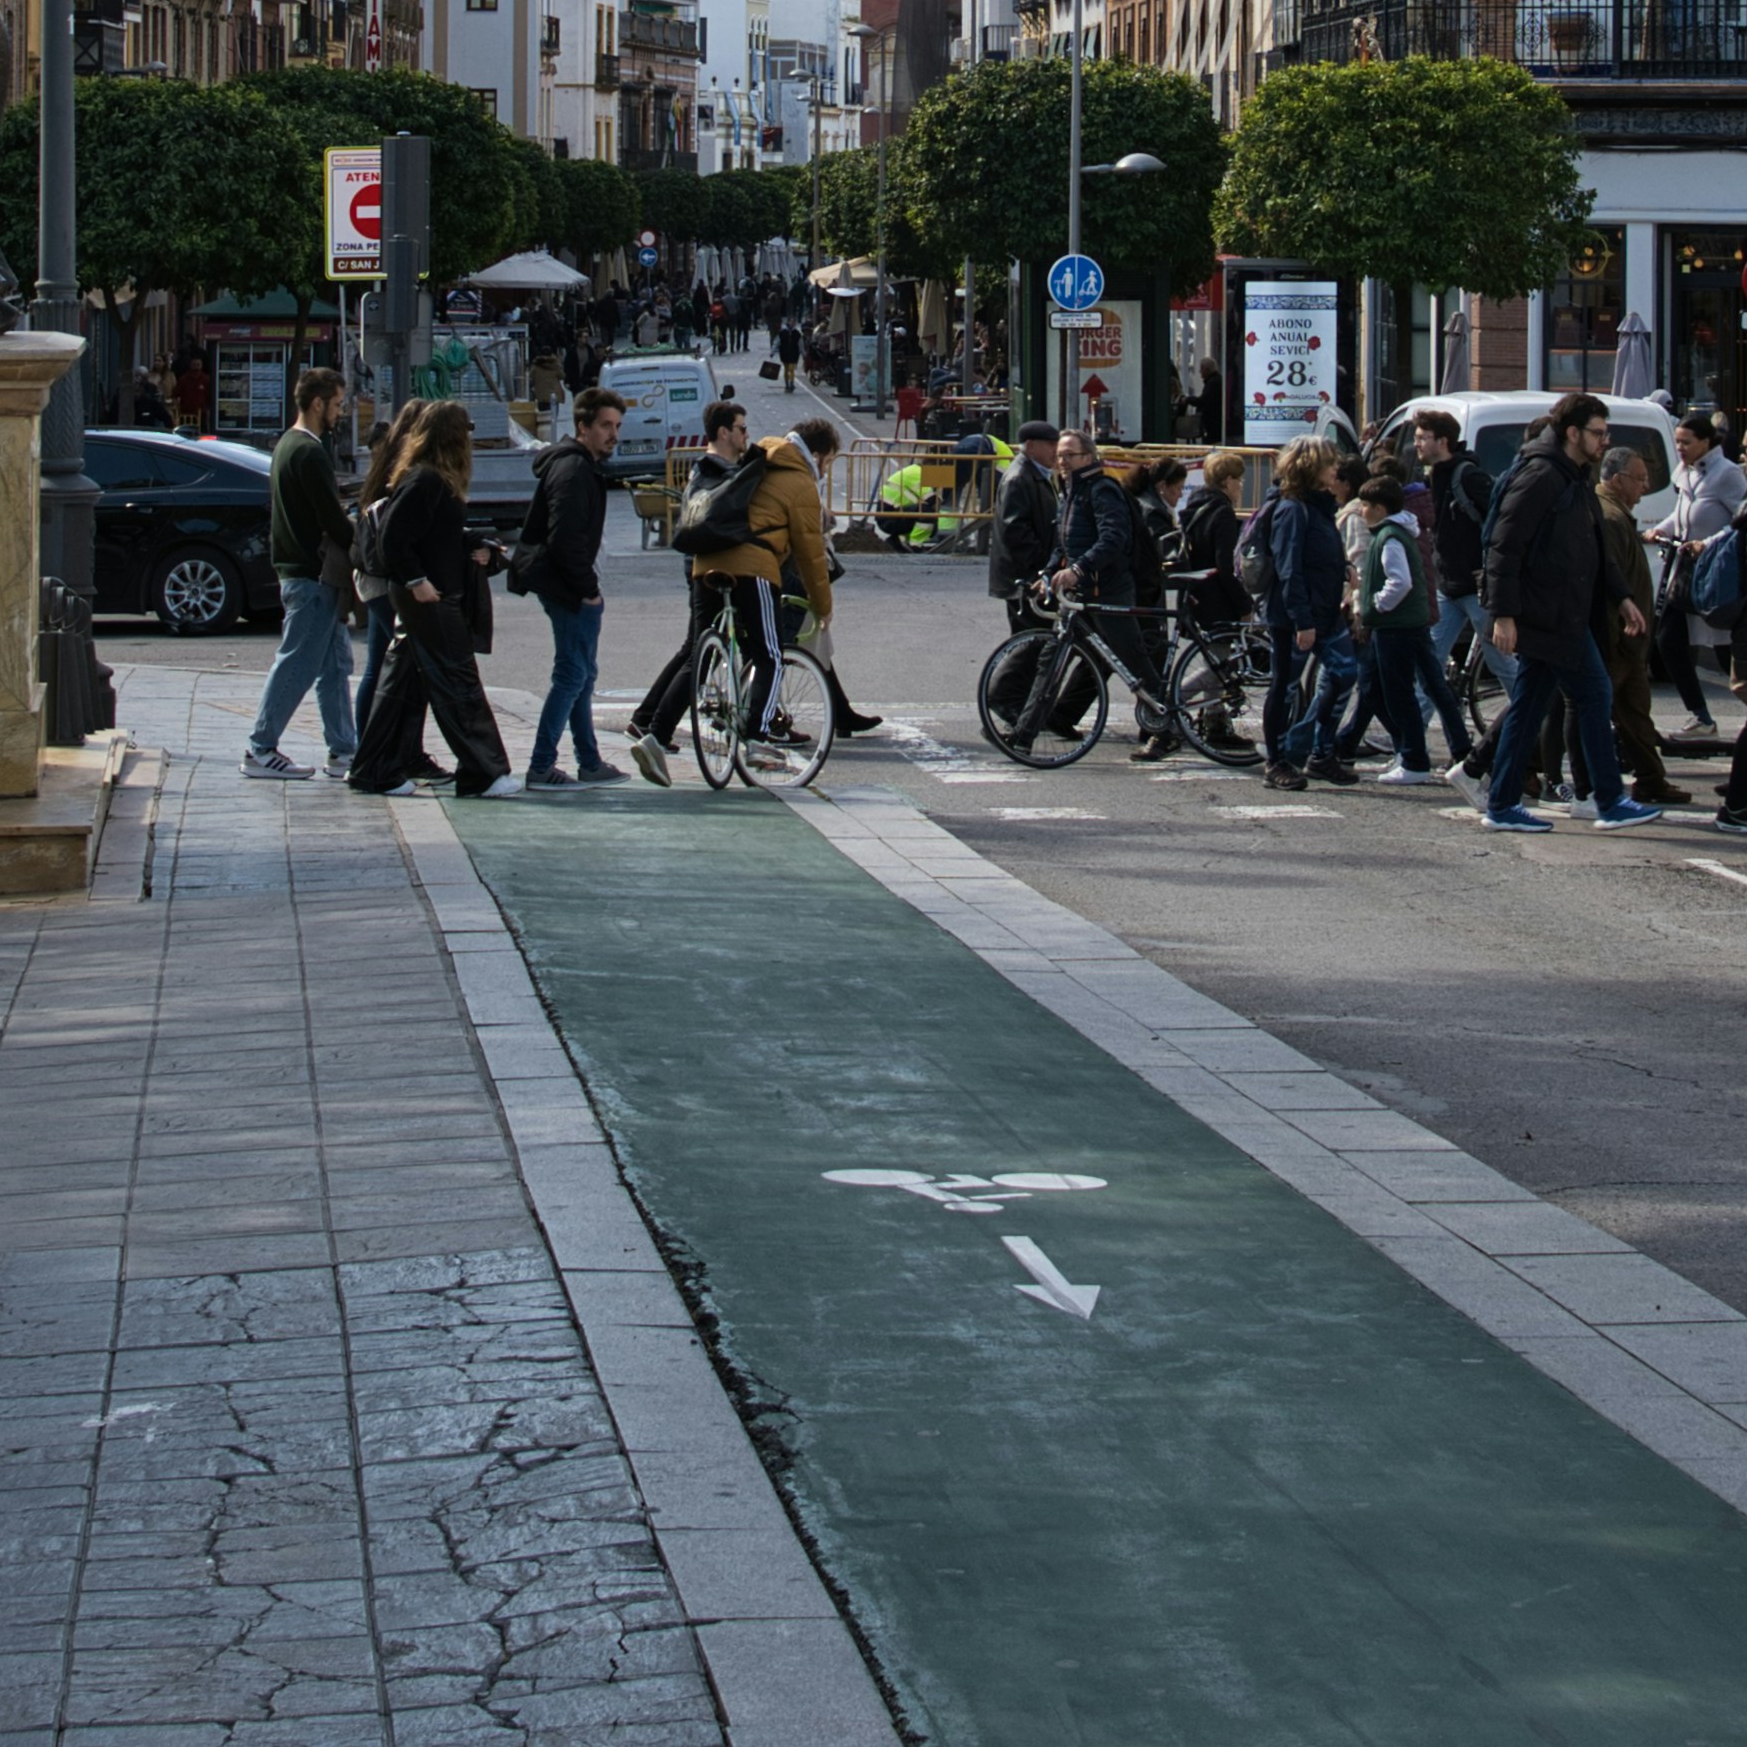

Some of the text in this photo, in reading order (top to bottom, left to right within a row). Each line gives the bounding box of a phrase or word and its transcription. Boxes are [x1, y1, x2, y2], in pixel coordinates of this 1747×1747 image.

[336, 242, 363, 251] ZONA
[337, 259, 349, 270] C/
[350, 258, 372, 270] SAN
[1268, 318, 1313, 329] ABONO
[1077, 325, 1122, 339] URGER
[1270, 332, 1309, 343] ANUAL
